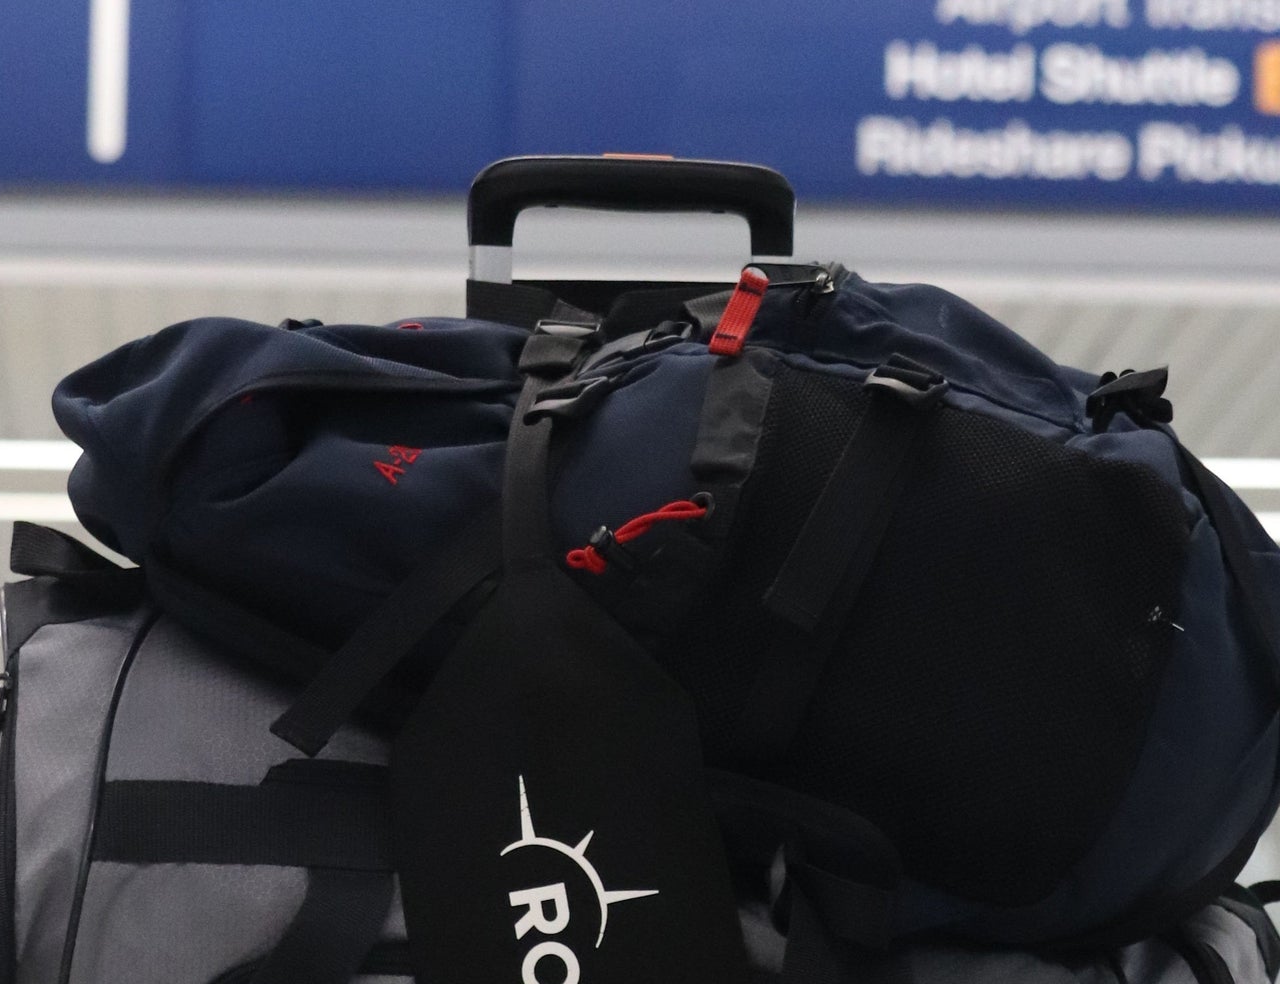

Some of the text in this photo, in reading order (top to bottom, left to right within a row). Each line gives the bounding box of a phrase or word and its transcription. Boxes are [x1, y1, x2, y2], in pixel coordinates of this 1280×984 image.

[884, 40, 1035, 101] Hotel
[1040, 43, 1240, 105] Shuttle
[855, 115, 1133, 181] Rideshare
